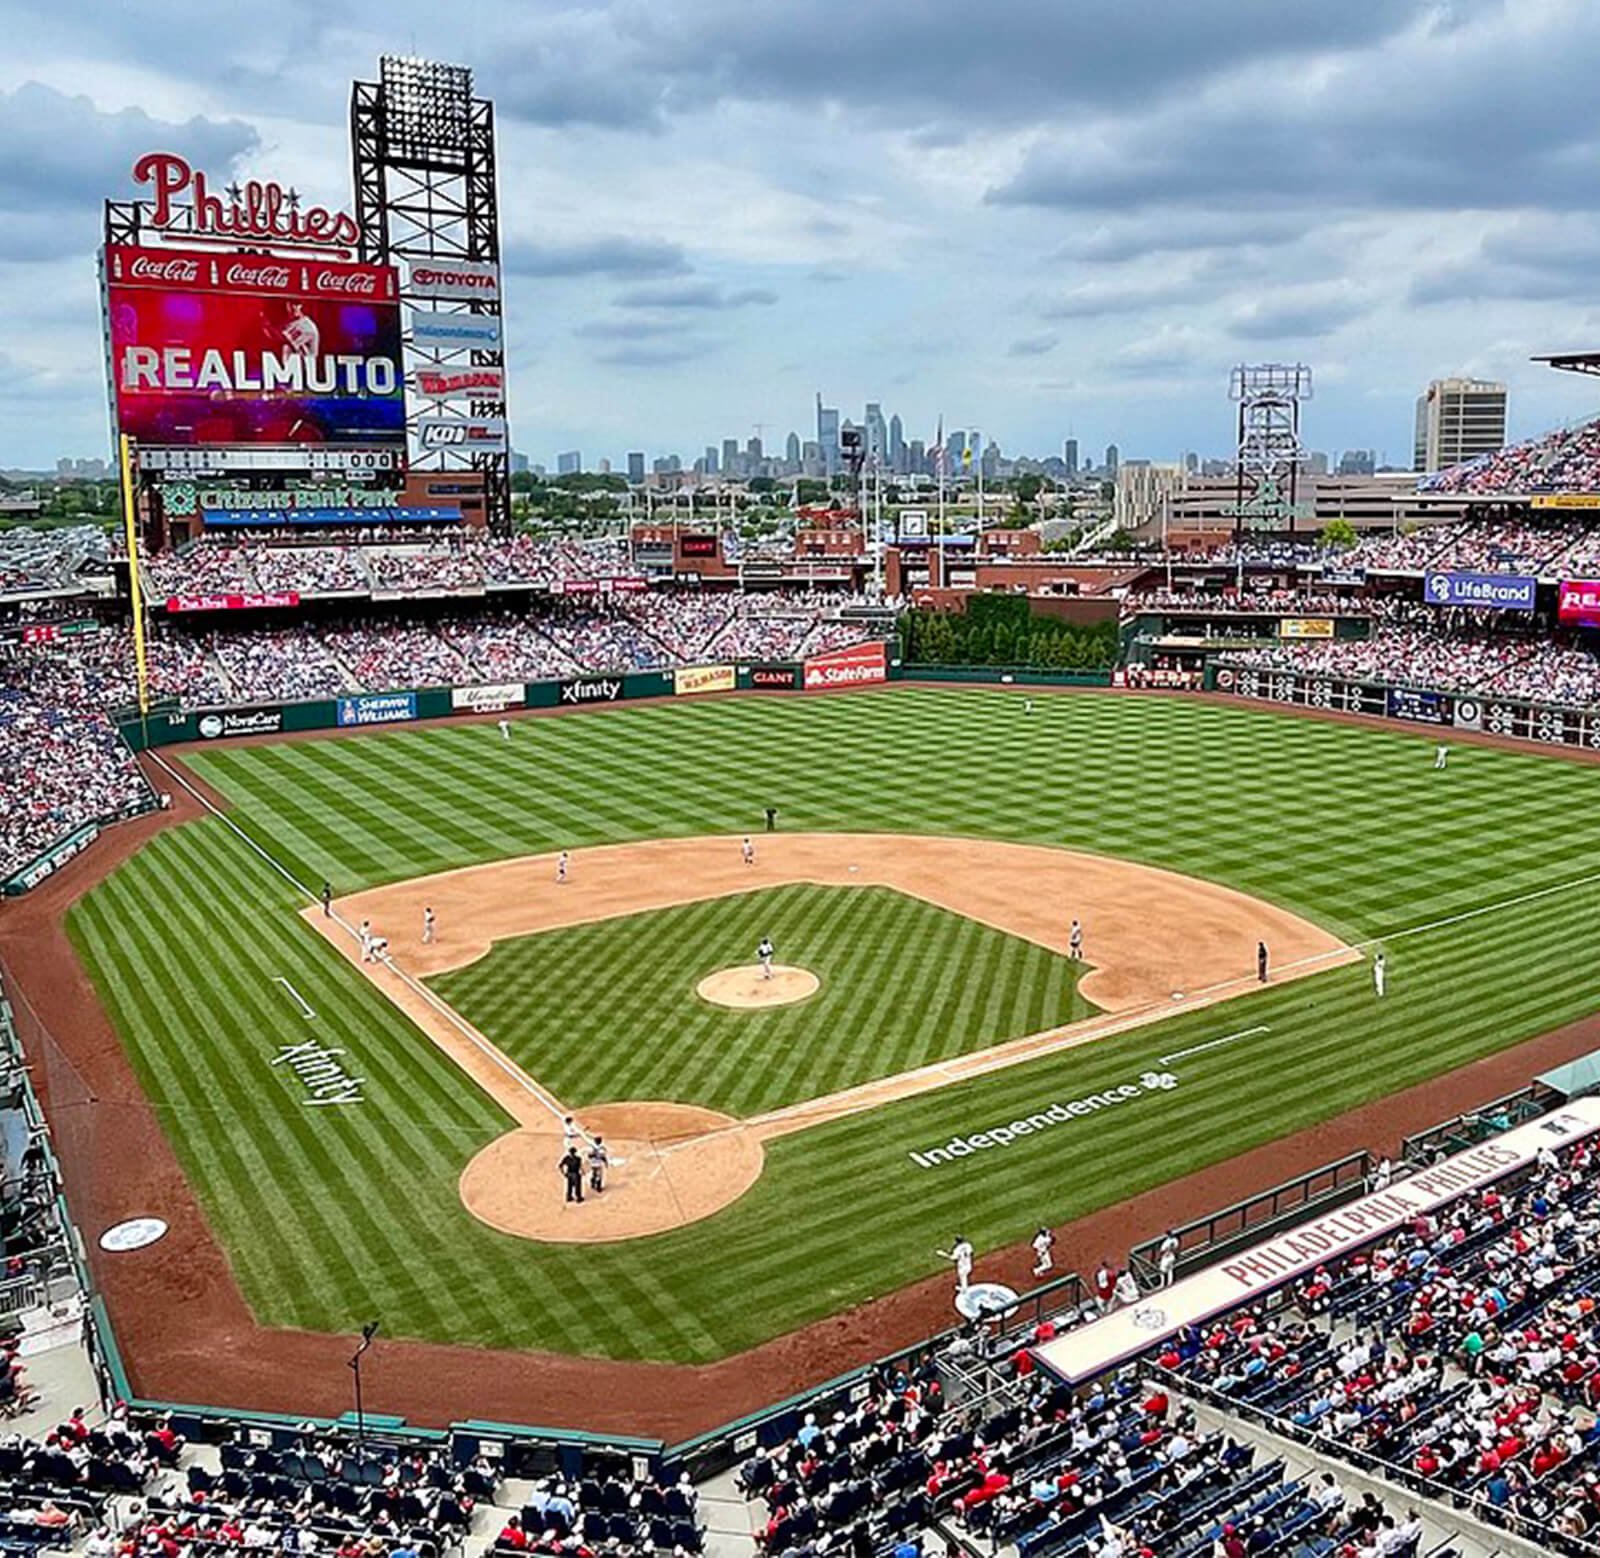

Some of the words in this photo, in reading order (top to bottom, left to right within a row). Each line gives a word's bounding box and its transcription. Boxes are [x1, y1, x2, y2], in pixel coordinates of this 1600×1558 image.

[133, 152, 361, 244] Phillies
[435, 272, 496, 289] TOYOTA
[123, 346, 395, 394] REALMUTO
[1454, 580, 1530, 601] LifeBrand
[1562, 592, 1600, 608] RE
[752, 672, 794, 683] GIANT
[562, 679, 621, 703] xfinity
[224, 711, 281, 728] NovaCare
[271, 1039, 366, 1106] xfinity
[909, 1084, 1141, 1168] Independence
[1221, 1193, 1420, 1287] PHILADELPHIA
[1411, 1145, 1521, 1197] PHILLIES
